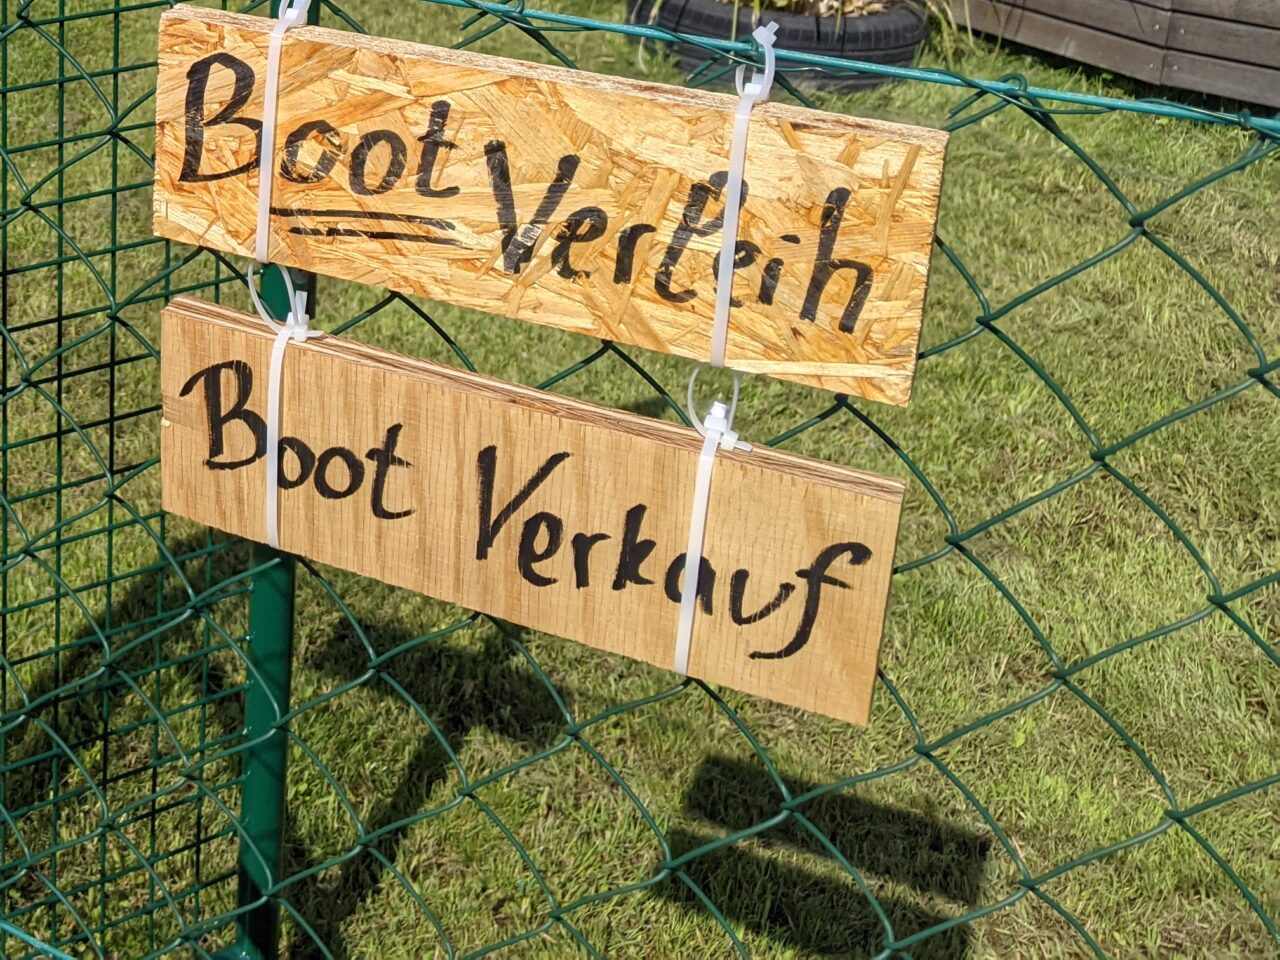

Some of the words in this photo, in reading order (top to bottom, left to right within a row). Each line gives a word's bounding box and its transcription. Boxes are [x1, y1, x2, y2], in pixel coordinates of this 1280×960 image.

[178, 52, 460, 199] Boot
[484, 139, 874, 334] Verleih
[179, 359, 416, 520] Boot
[475, 444, 872, 660] Verkauf
